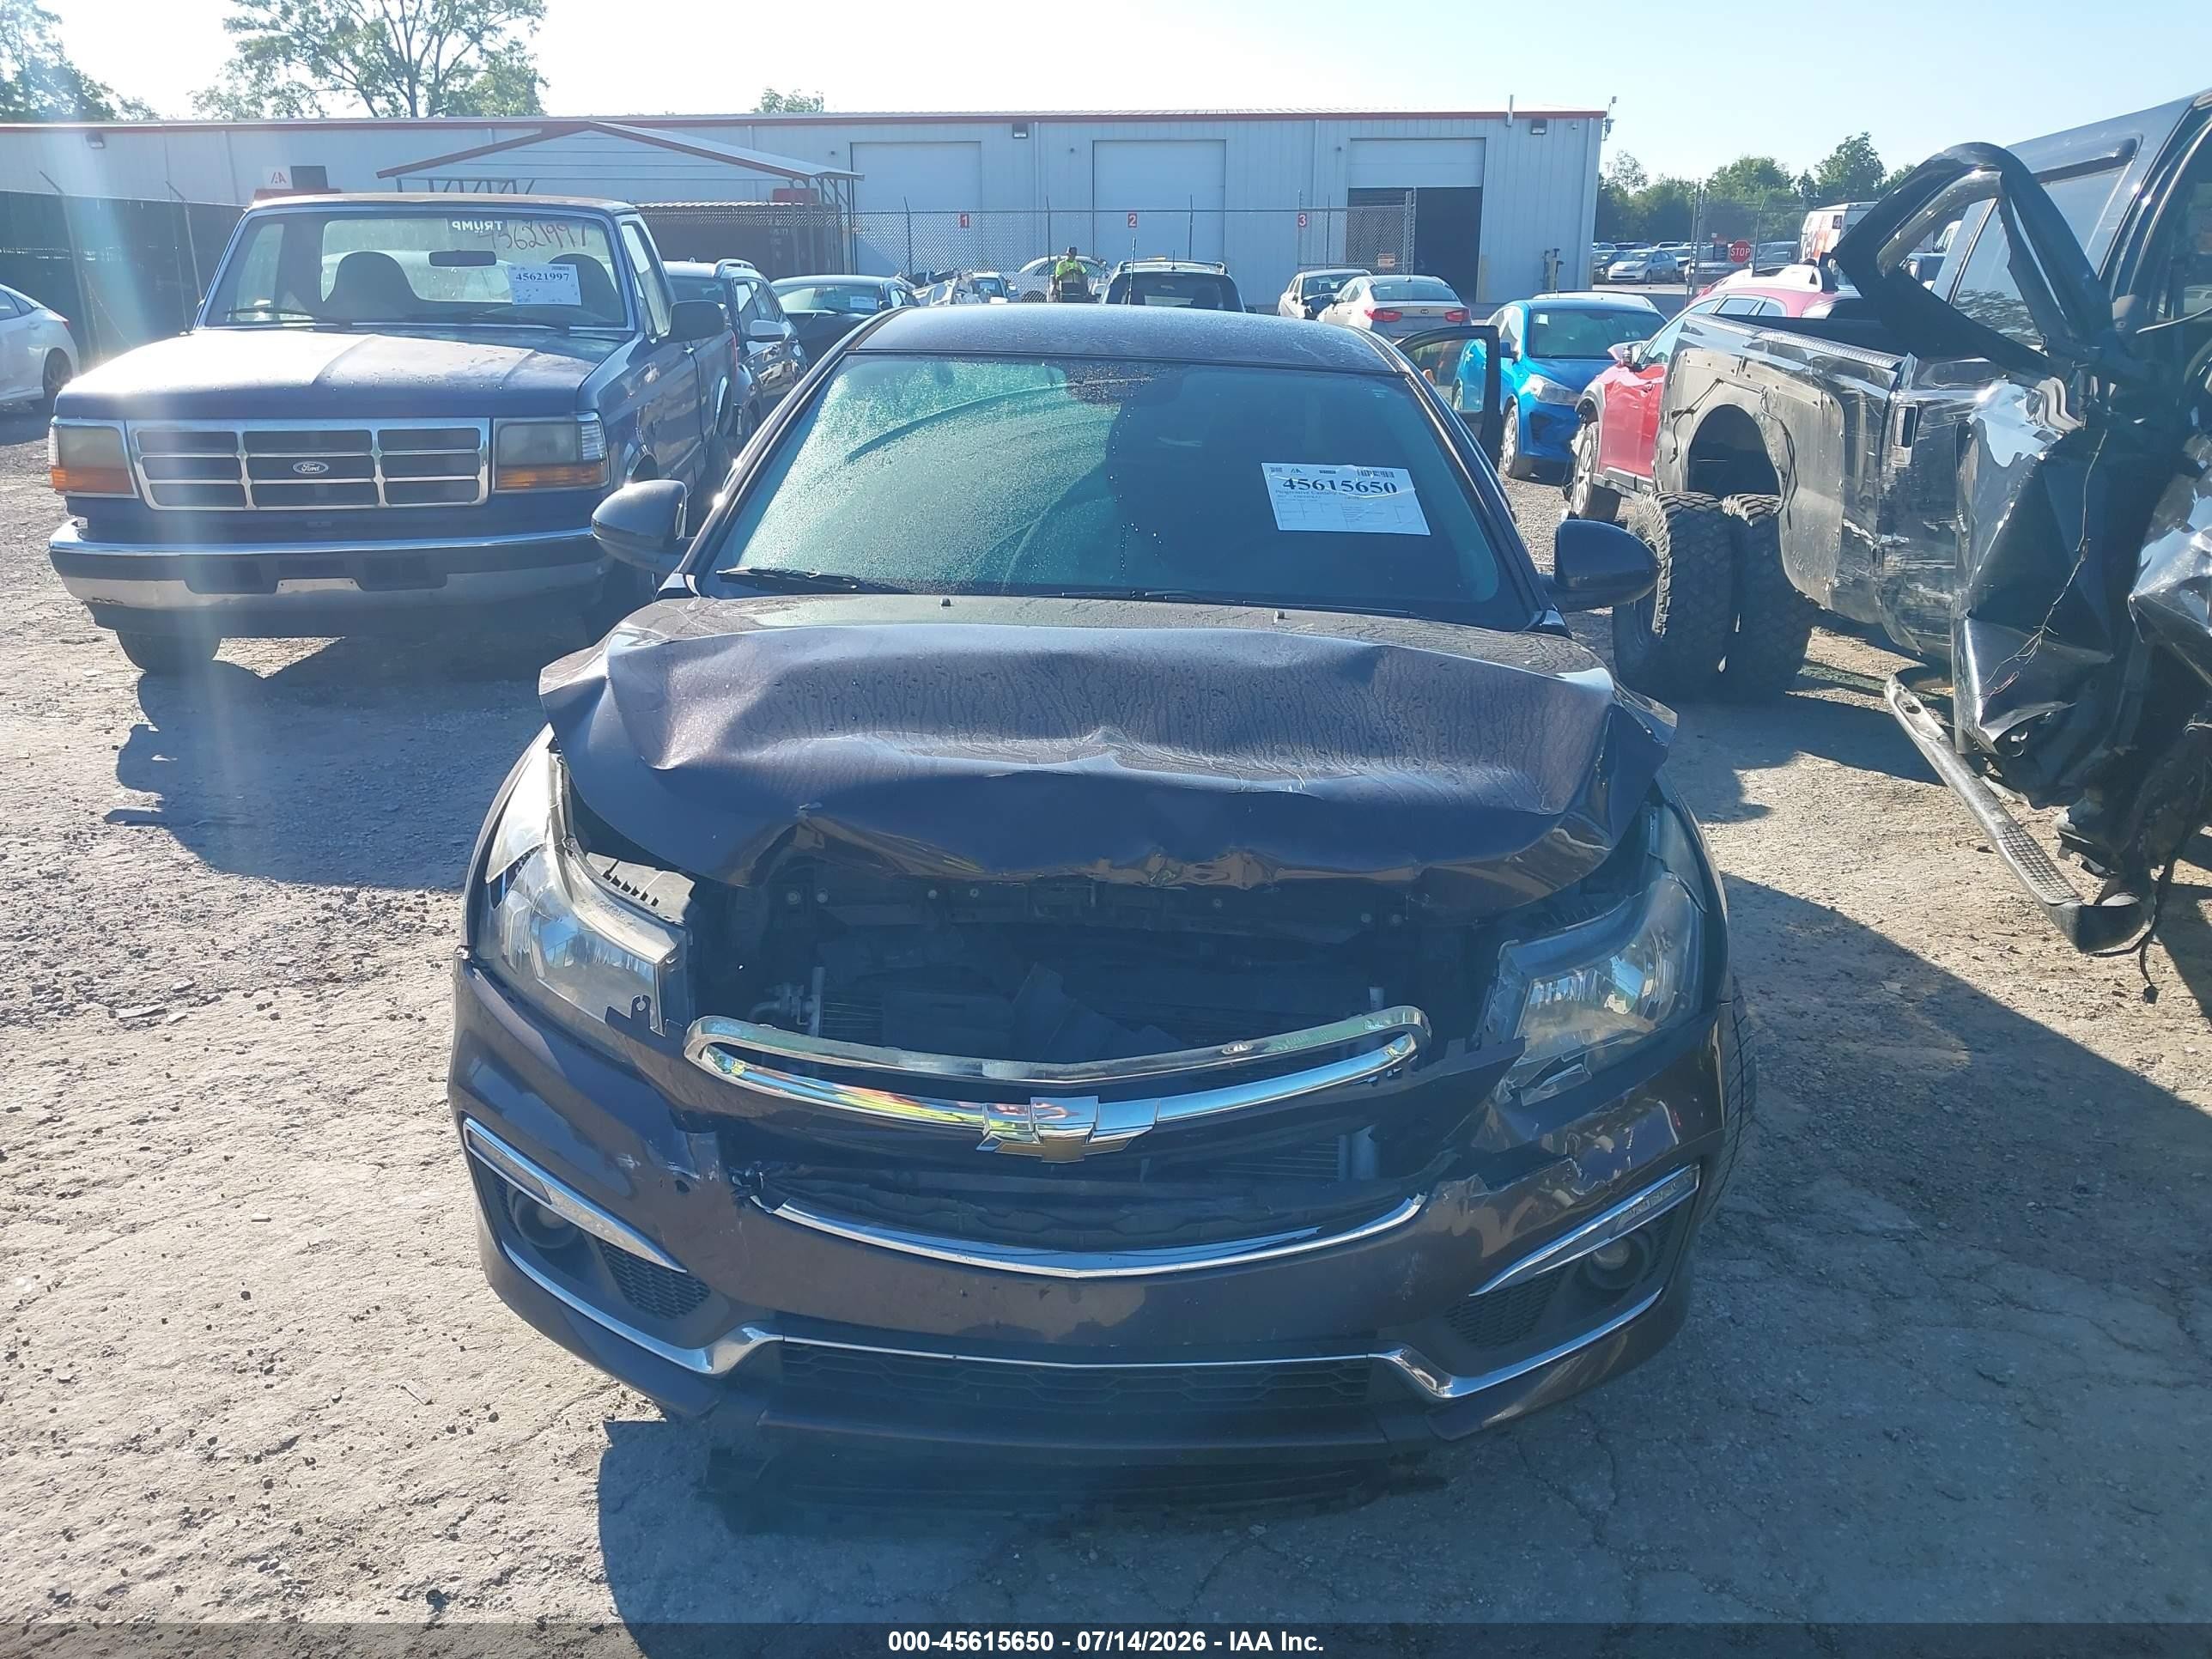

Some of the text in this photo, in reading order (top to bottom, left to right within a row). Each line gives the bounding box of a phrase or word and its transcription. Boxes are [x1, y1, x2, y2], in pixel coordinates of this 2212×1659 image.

[961, 215, 968, 227] 1
[1128, 215, 1136, 227] 2
[1298, 214, 1306, 227] 3
[1833, 216, 1841, 228] 4
[1730, 247, 1751, 257] STOP
[515, 272, 570, 282] 45621997
[301, 463, 320, 471] Ford
[1283, 477, 1398, 494] 45615650
